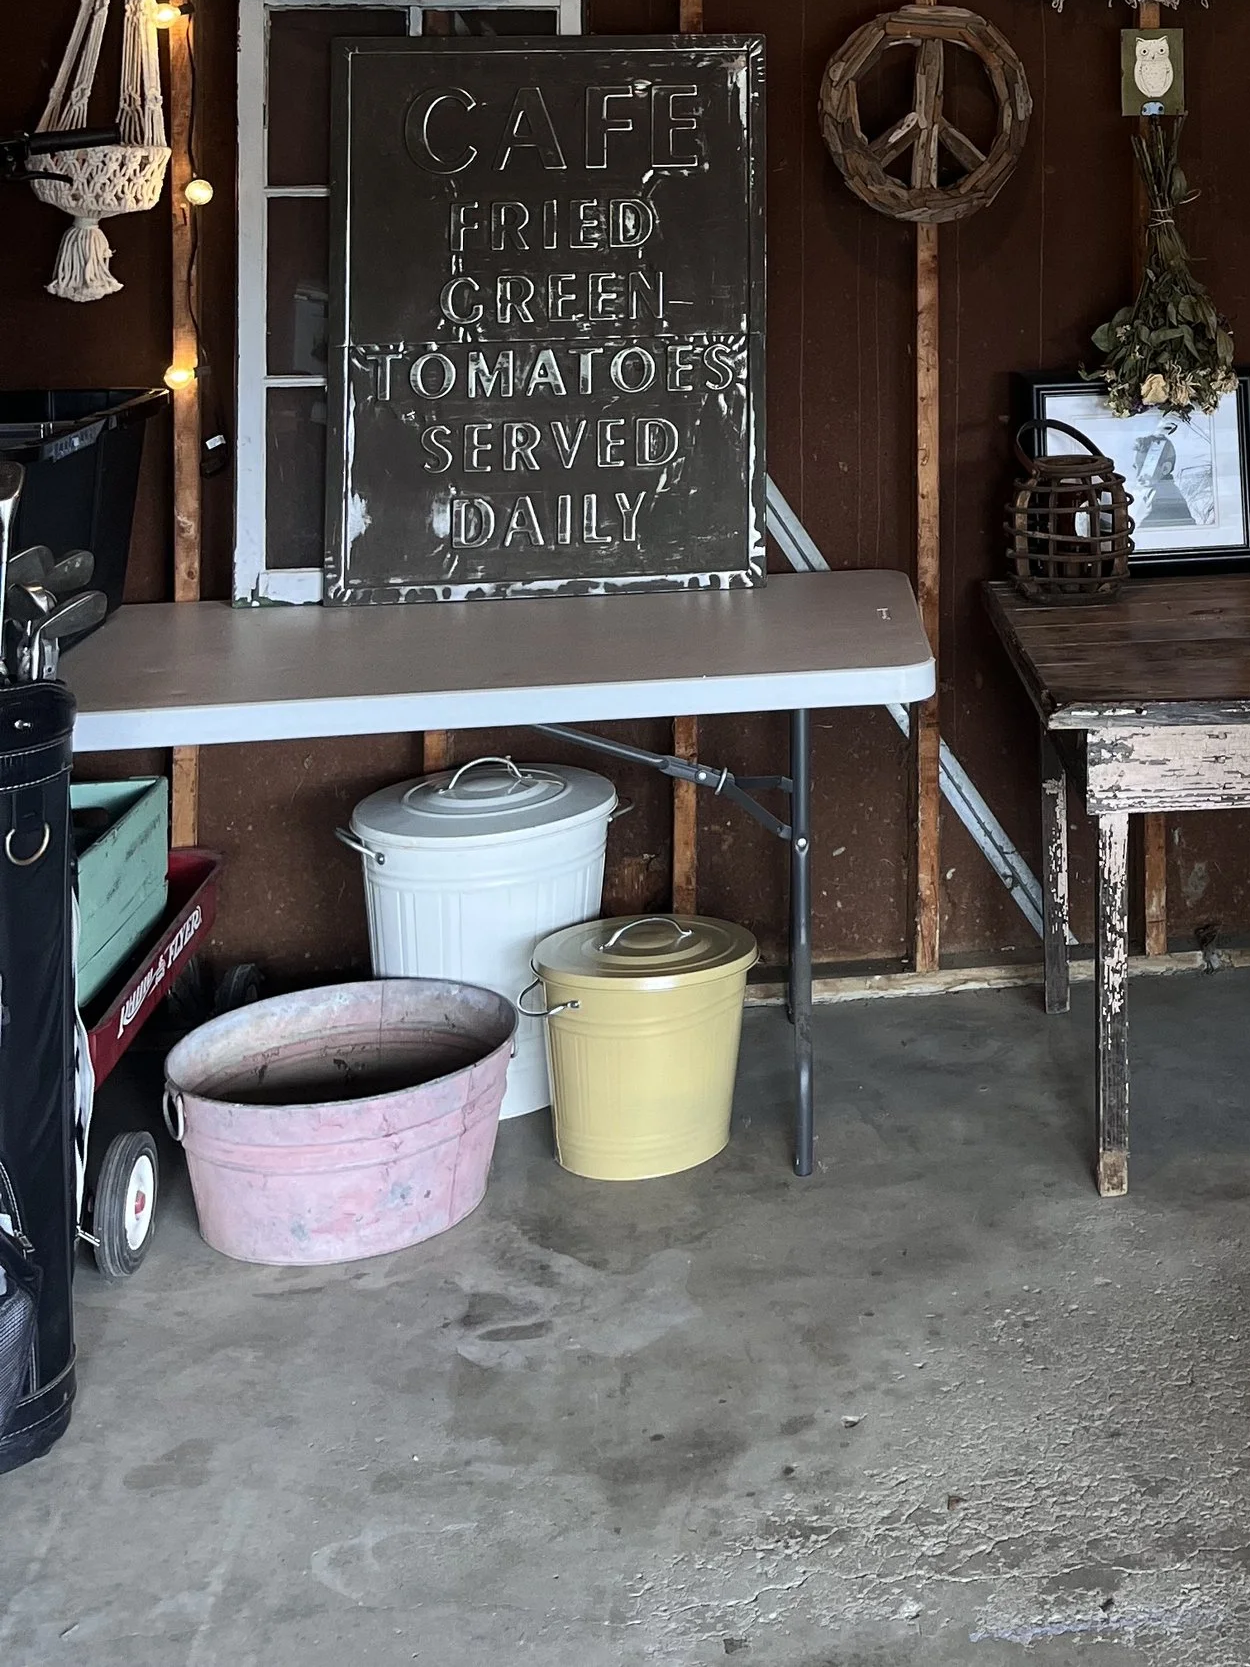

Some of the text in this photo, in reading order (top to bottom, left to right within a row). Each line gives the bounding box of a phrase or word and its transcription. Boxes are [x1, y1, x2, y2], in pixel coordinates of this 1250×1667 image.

[403, 84, 700, 176] CAFE
[448, 197, 656, 253] FRIED
[367, 343, 738, 401] TOMATOES
[420, 417, 680, 475] SERVED
[450, 490, 648, 550] DAILY
[166, 905, 202, 969] FLYER
